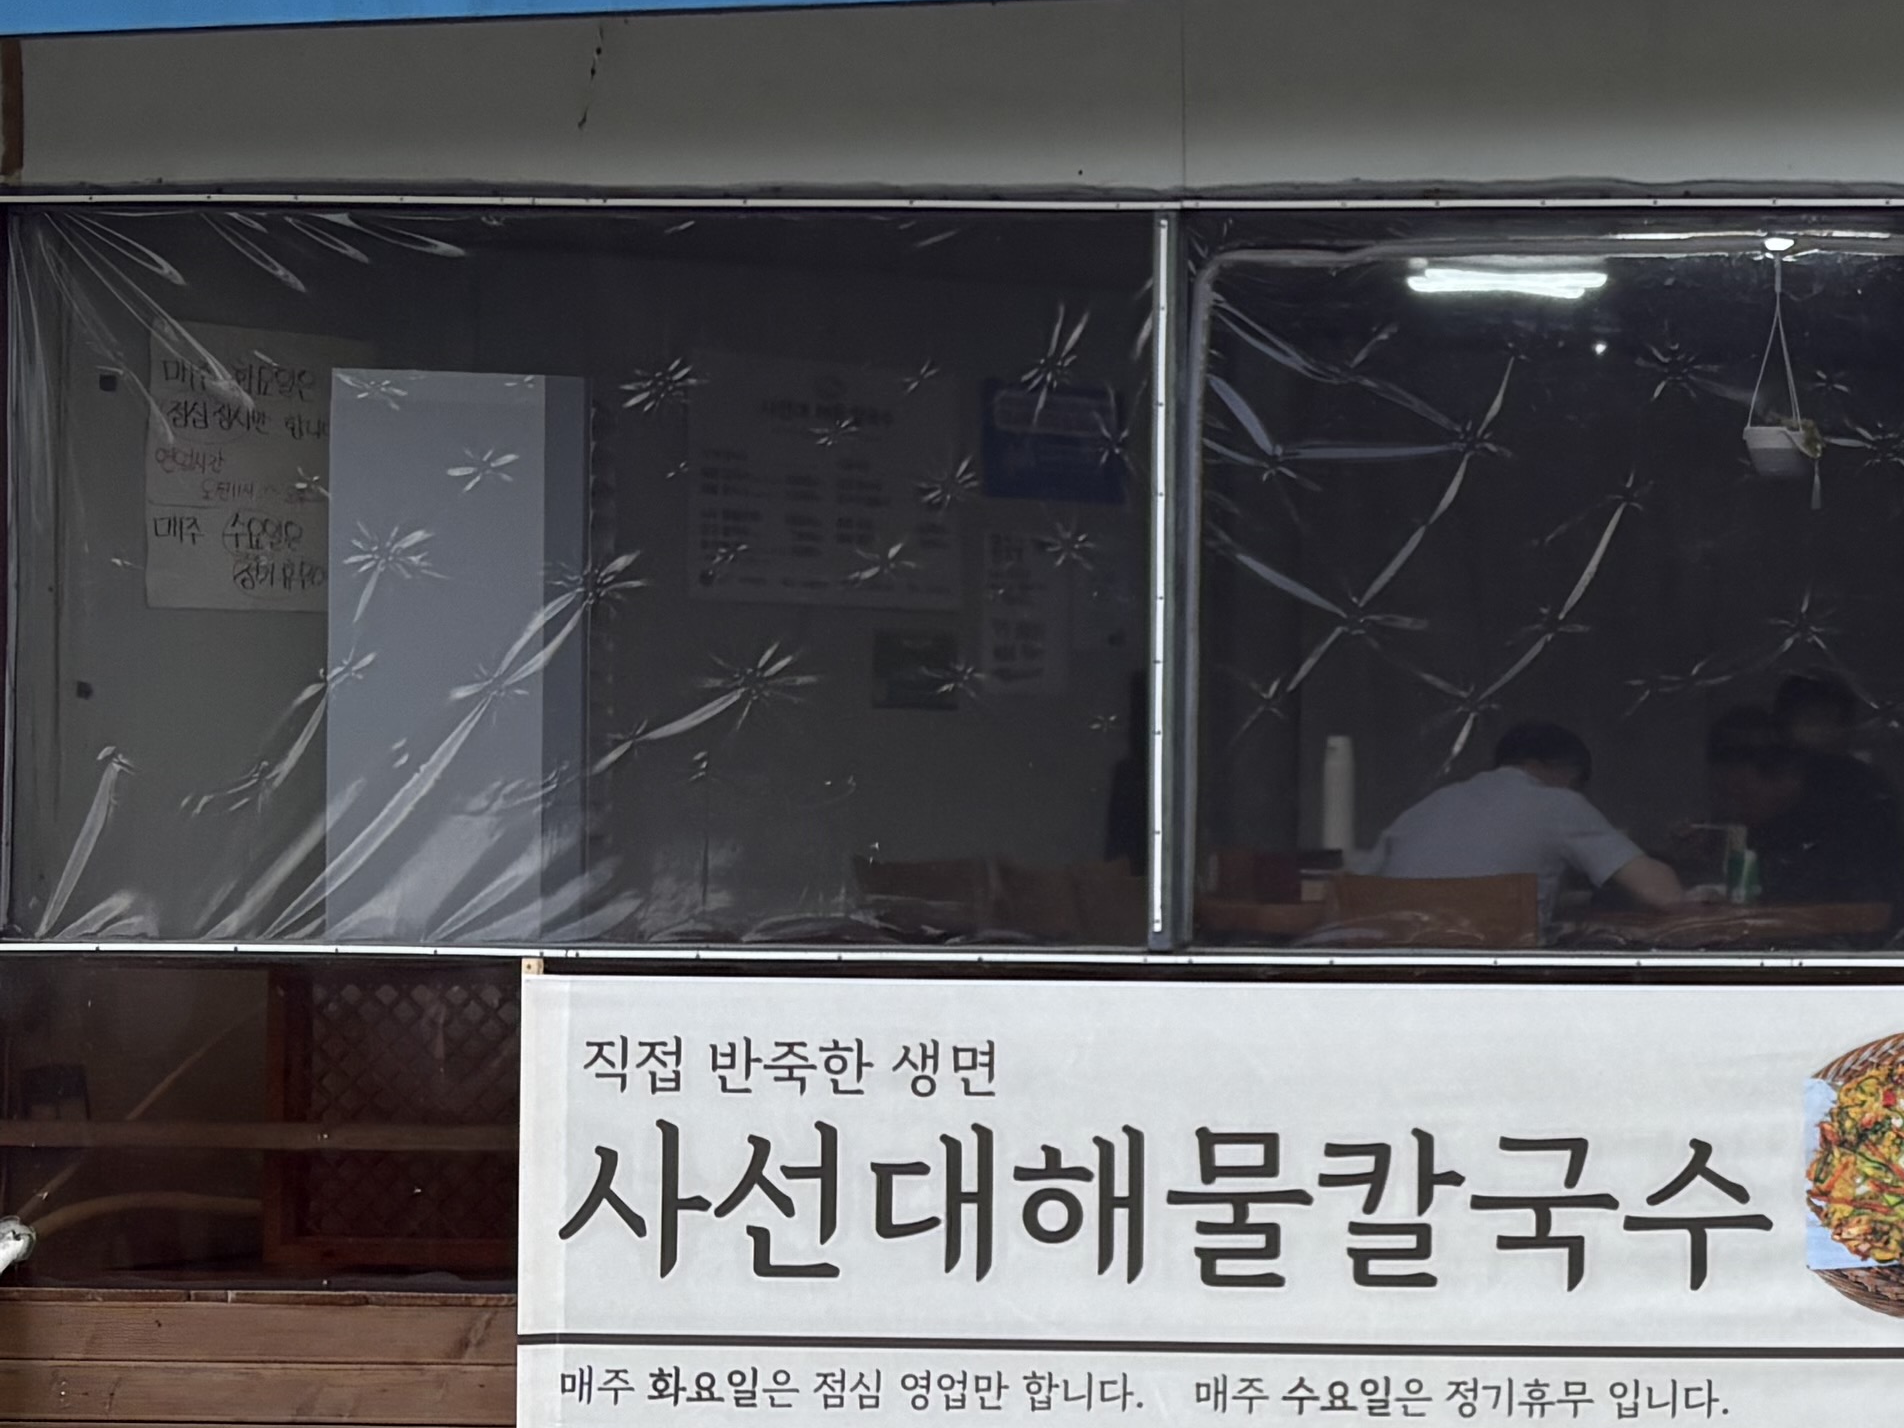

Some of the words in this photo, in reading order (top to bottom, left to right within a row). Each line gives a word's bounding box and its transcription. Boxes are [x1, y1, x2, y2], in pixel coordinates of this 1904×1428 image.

[583, 1034, 682, 1096] 직접
[709, 1035, 875, 1096] 반죽한
[891, 1038, 996, 1098] 생면
[558, 1118, 1774, 1292] 사선대해물칼국수
[560, 1364, 635, 1406] 매주
[647, 1365, 800, 1408] 화요일은
[813, 1367, 881, 1410] 점심
[900, 1369, 1010, 1412] 영업만
[1022, 1370, 1144, 1413] 합니다.
[1195, 1373, 1270, 1415] 매주
[1281, 1375, 1433, 1417] 수요일은
[1445, 1377, 1595, 1419] 정기휴무
[1609, 1378, 1729, 1420] 입니다.
